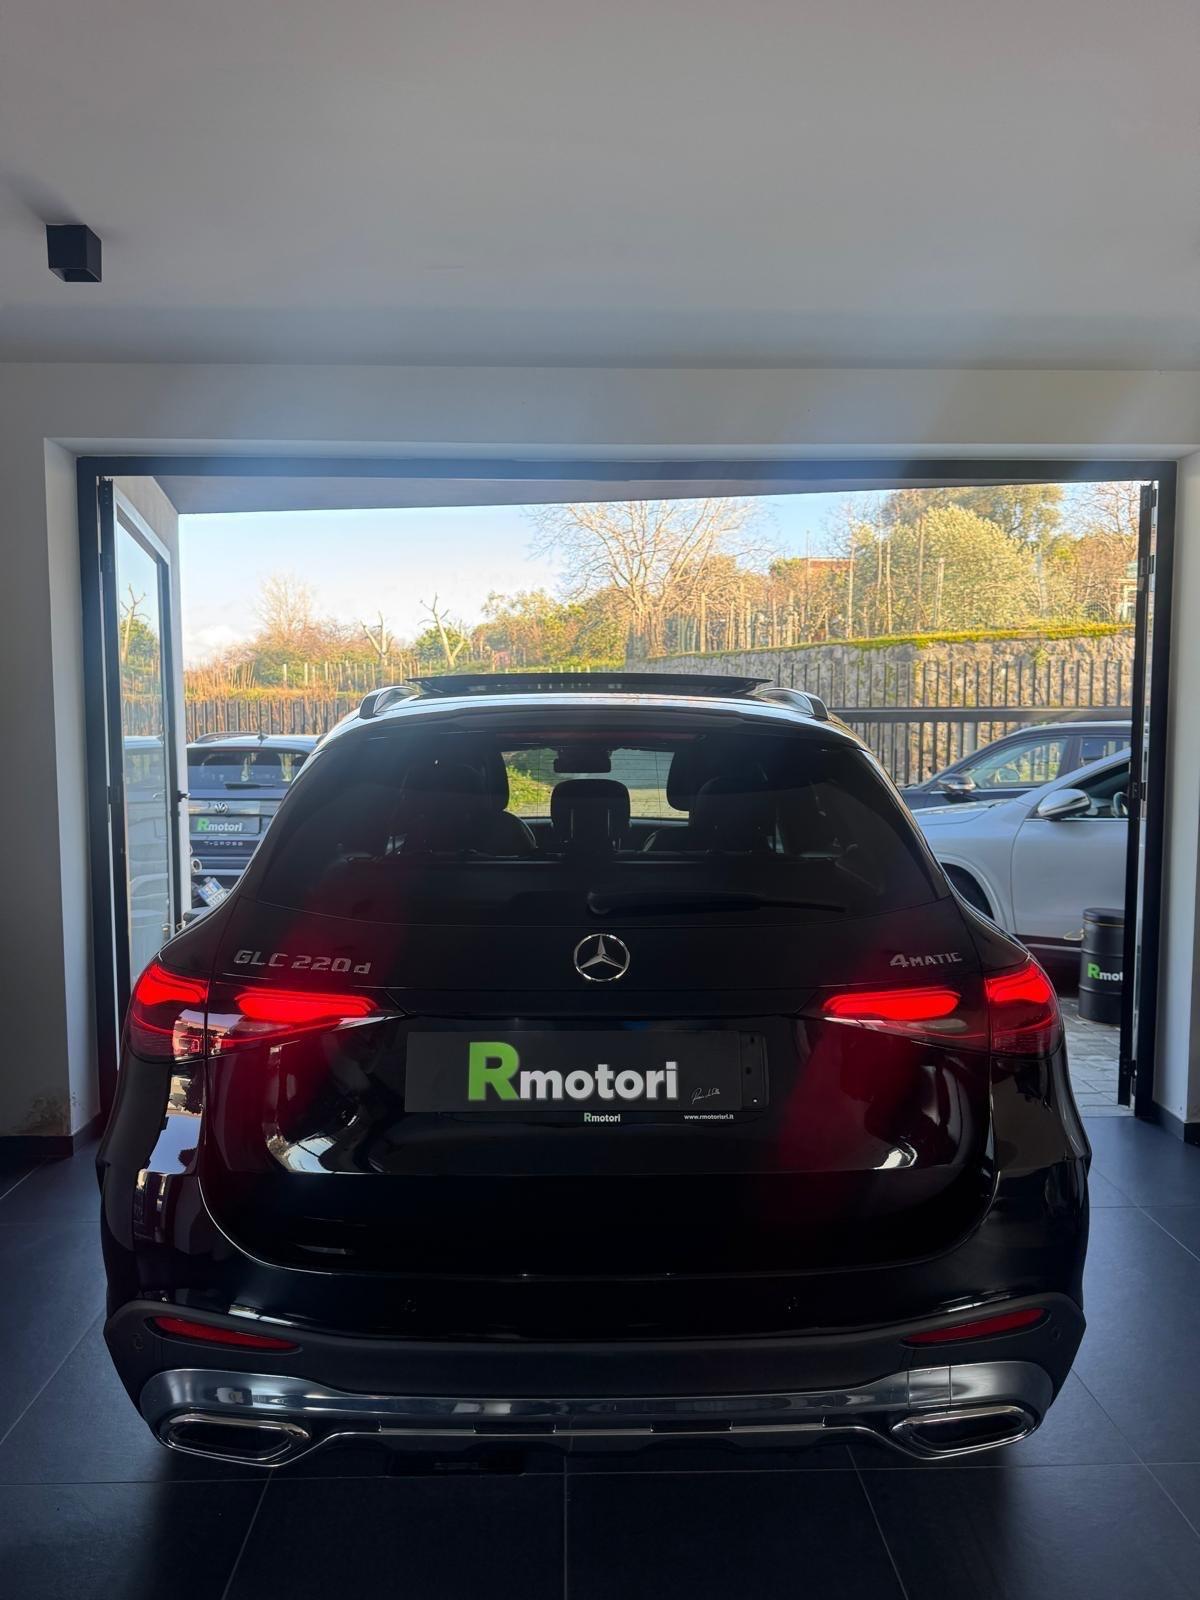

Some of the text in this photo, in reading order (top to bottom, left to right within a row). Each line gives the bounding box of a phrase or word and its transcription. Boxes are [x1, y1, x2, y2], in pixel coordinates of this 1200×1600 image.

[197, 818, 243, 832] Rmotori
[233, 949, 289, 968] GLC
[889, 952, 963, 968] 4MATIC
[468, 1041, 678, 1100] Rmotori
[583, 1112, 621, 1123] Rmotori
